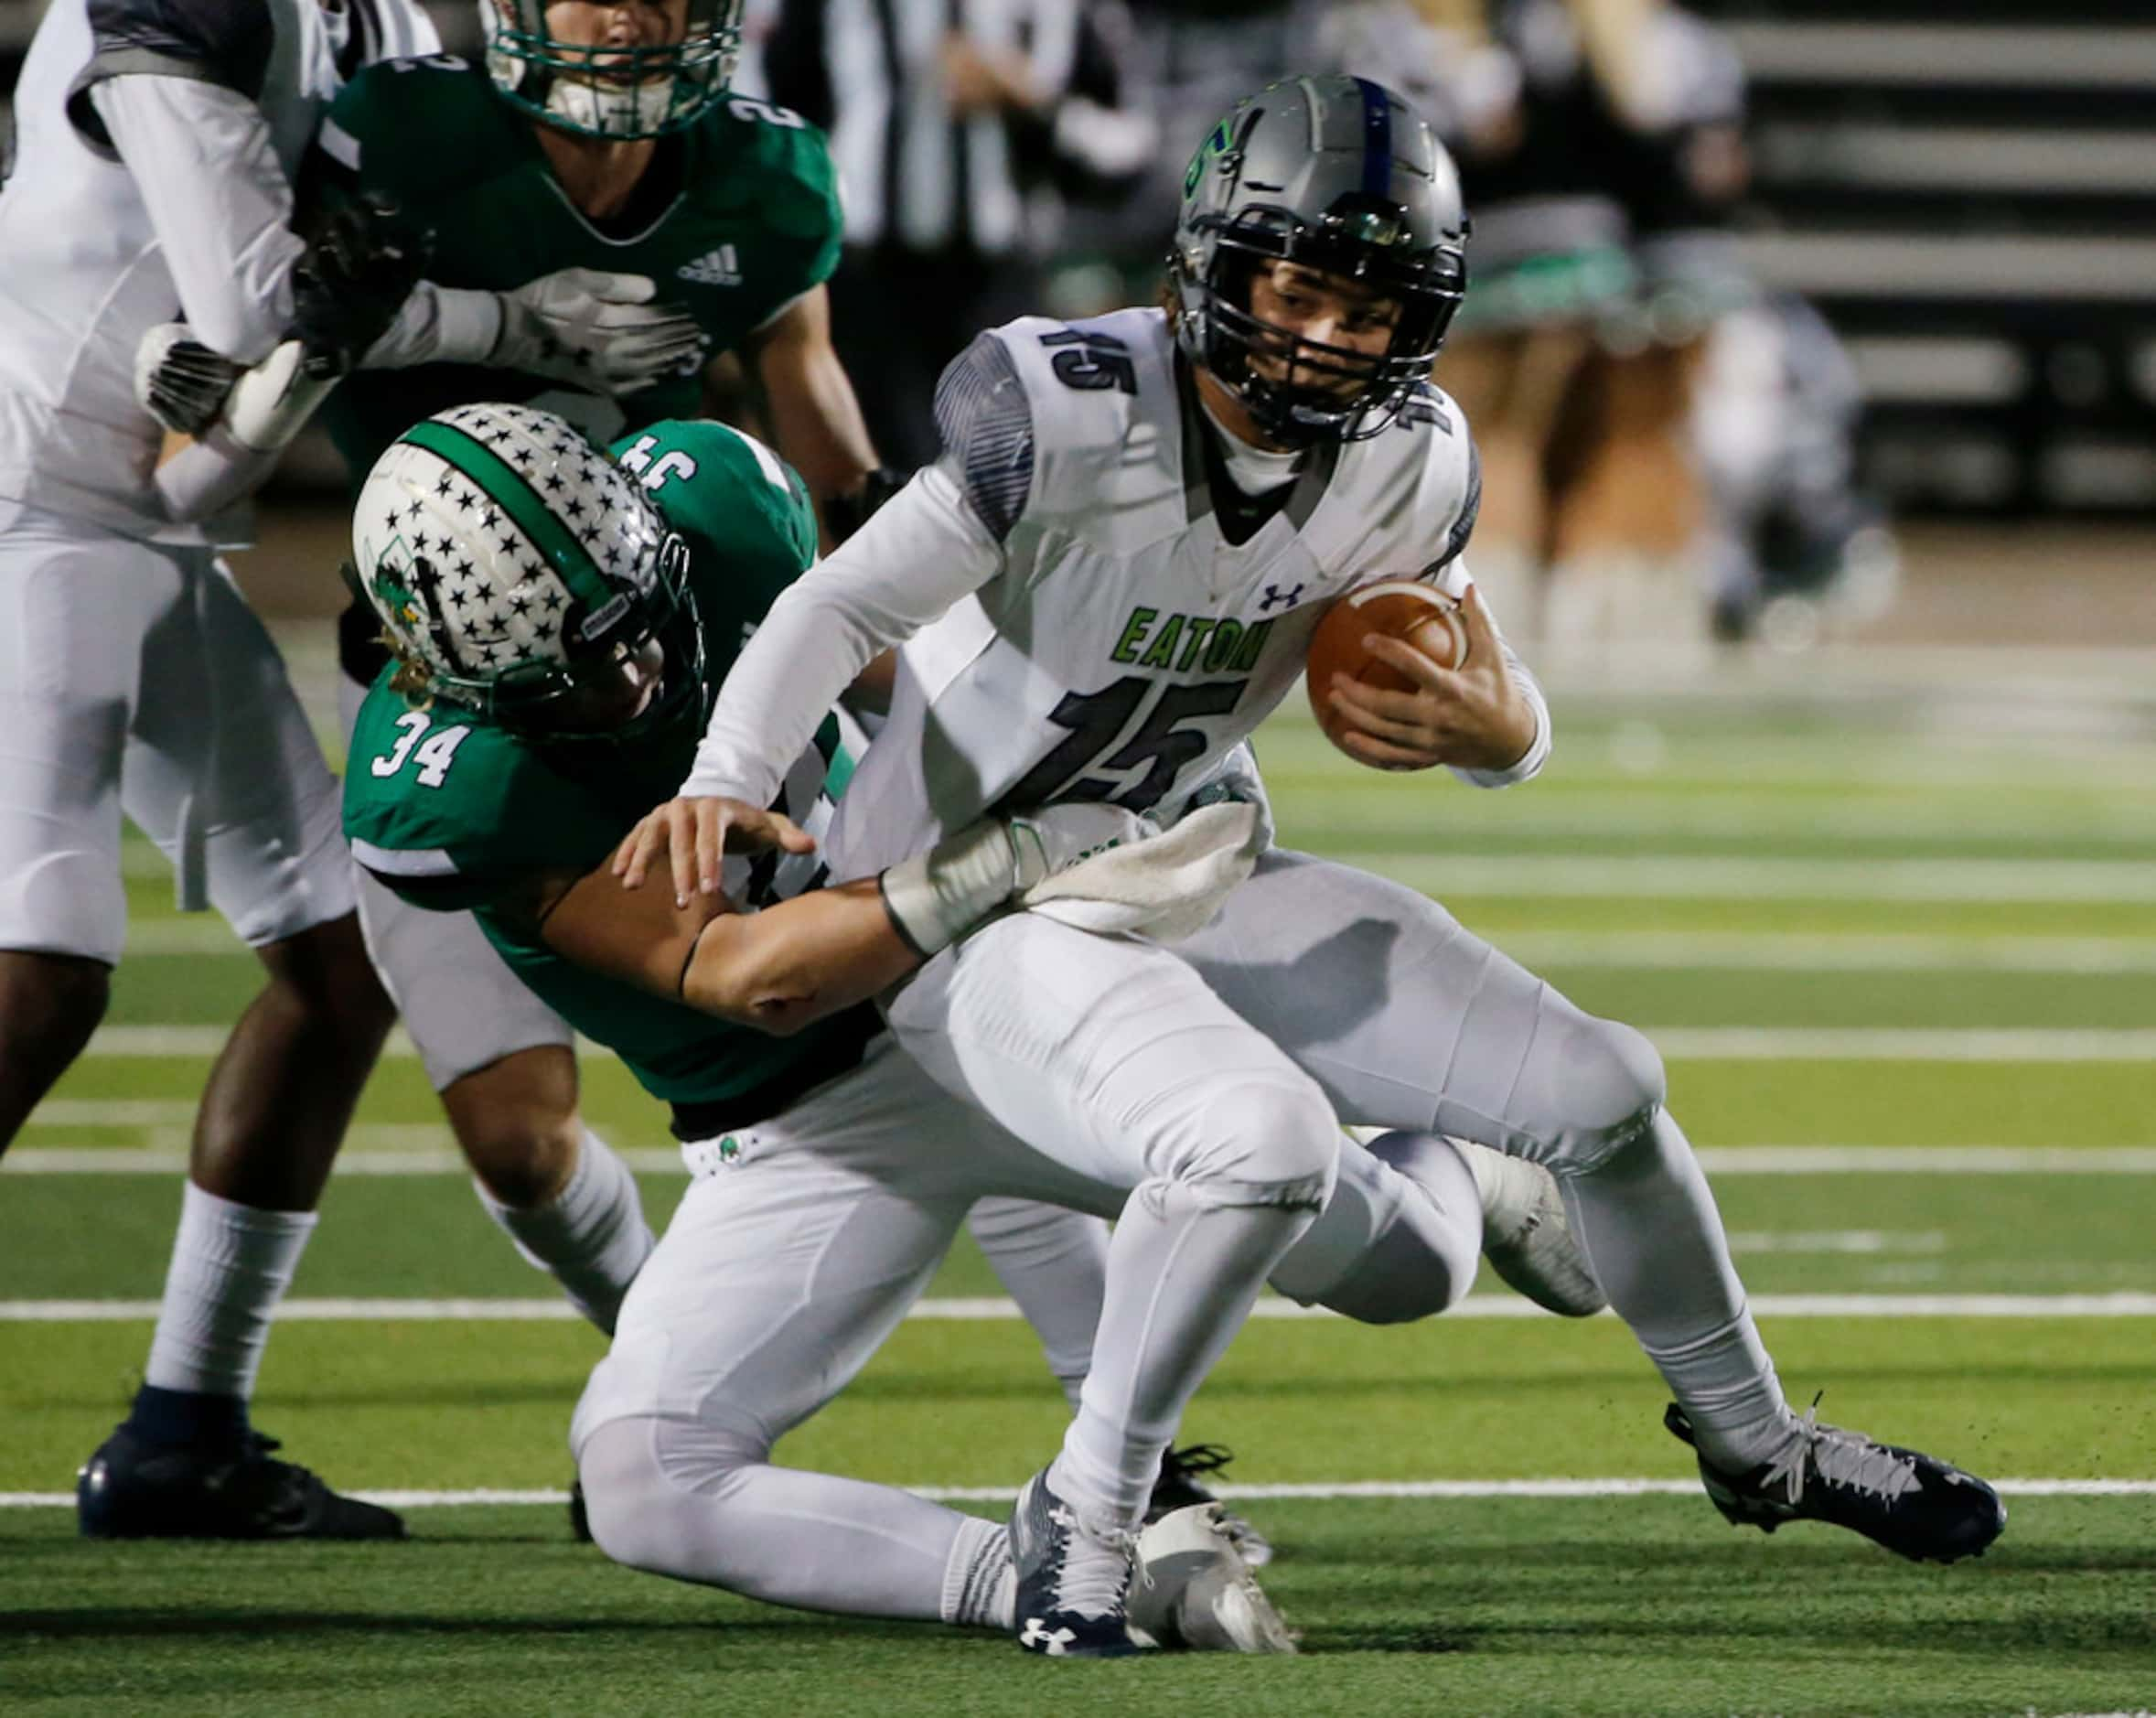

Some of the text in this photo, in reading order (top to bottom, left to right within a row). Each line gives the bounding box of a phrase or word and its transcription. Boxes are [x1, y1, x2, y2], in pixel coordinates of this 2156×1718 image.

[728, 101, 806, 128] 2
[1039, 330, 1138, 395] 15
[1110, 607, 1275, 673] EATON
[370, 712, 472, 789] 34
[988, 676, 1250, 814] 15
